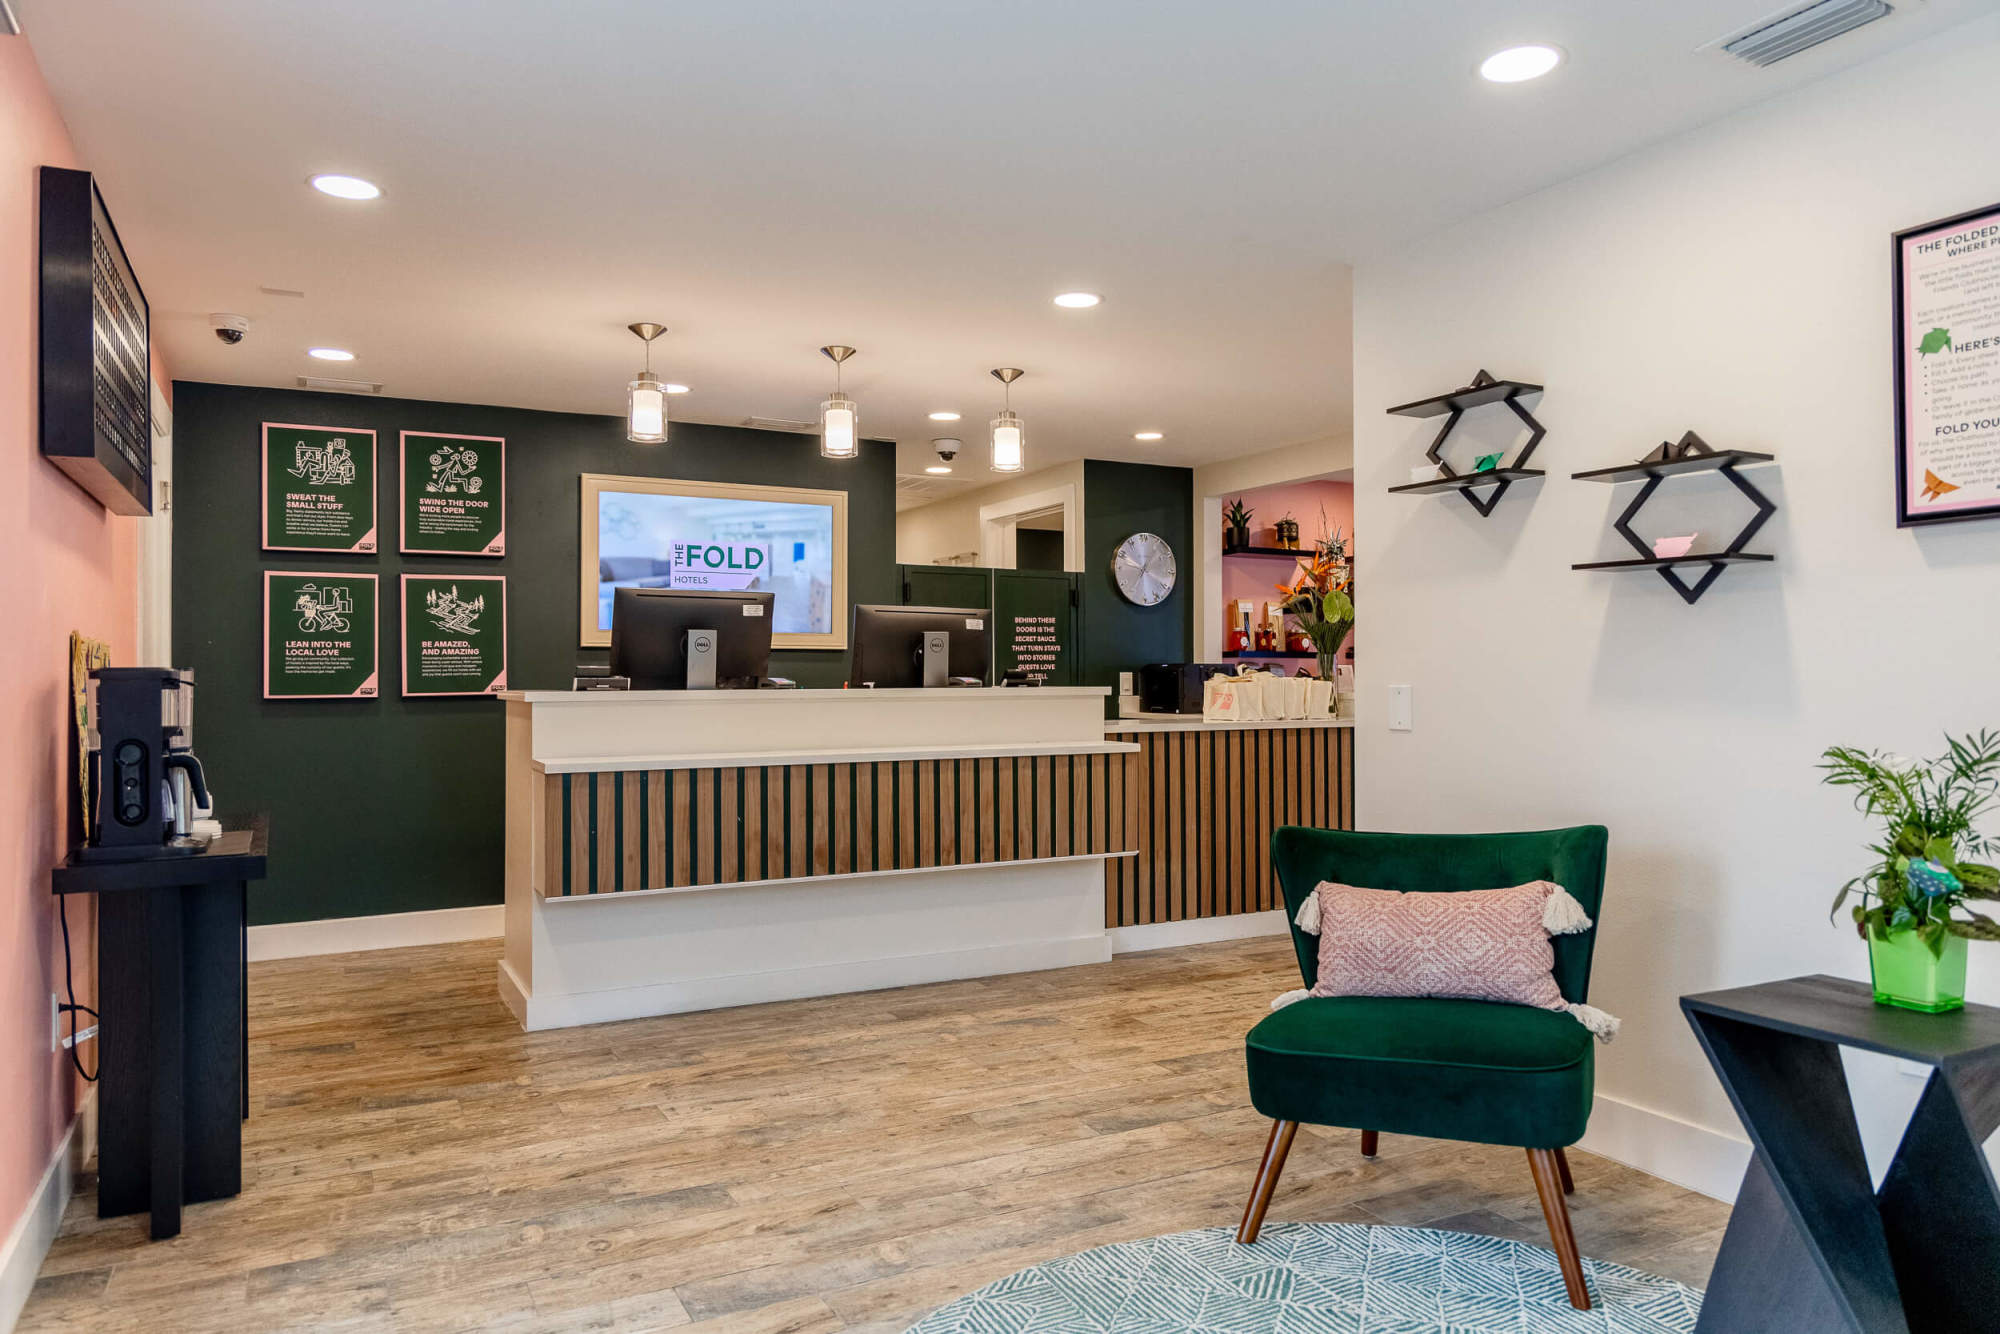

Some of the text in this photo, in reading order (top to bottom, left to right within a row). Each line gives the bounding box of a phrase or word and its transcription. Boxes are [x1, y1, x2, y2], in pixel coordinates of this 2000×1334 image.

[1917, 226, 1998, 254] THE FOLDED
[1947, 241, 1987, 257] WHERE
[1955, 336, 2000, 353] HERE'S
[1935, 417, 2000, 436] FOLD YOU
[286, 493, 317, 501] SWEAT
[419, 498, 489, 508] SWING THE DOOR
[286, 501, 344, 510] SMALL STUFF
[675, 544, 764, 570] THE FOLD
[674, 576, 708, 584] HOTELS
